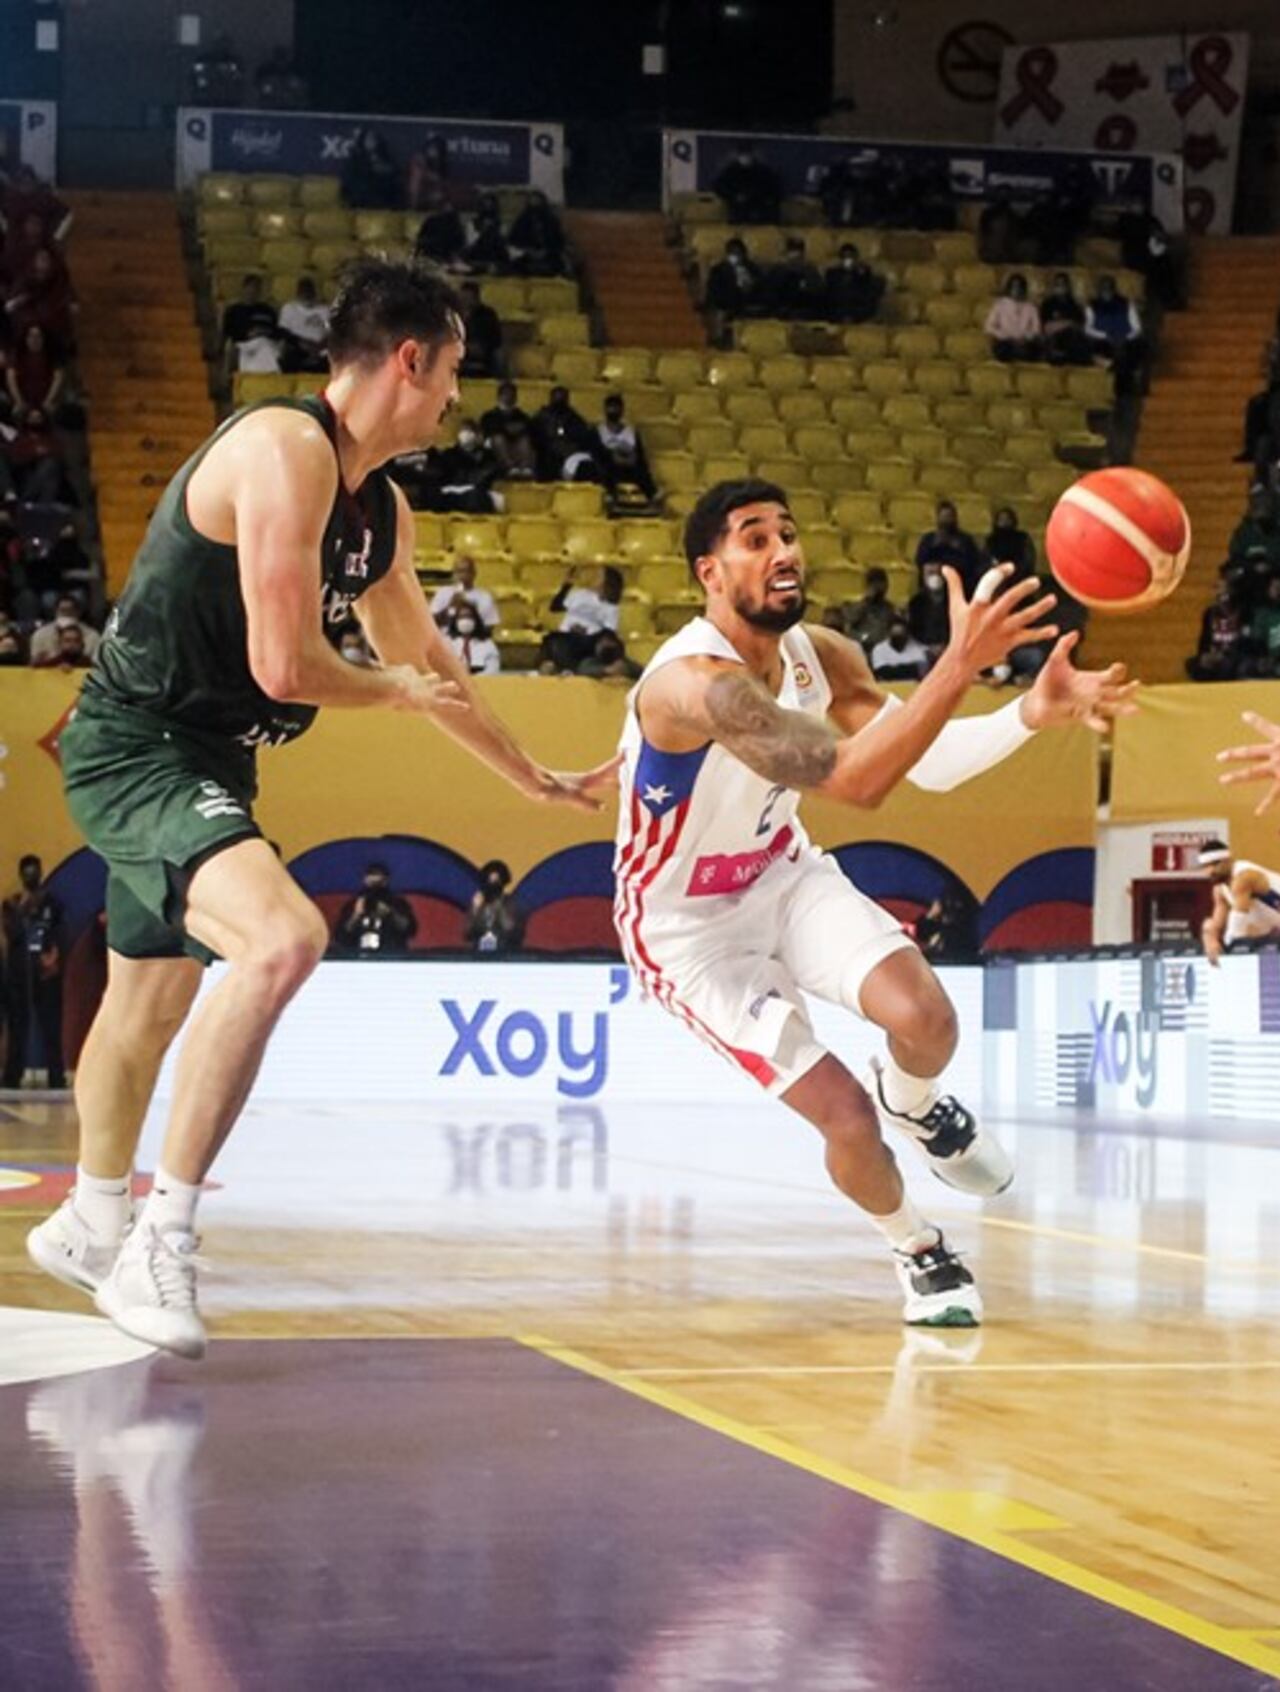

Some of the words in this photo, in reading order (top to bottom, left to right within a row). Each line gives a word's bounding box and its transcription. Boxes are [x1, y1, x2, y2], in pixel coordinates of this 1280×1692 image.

[186, 117, 207, 141] Q
[533, 133, 555, 156] Q
[673, 140, 692, 163] Q
[1156, 162, 1175, 186] Q
